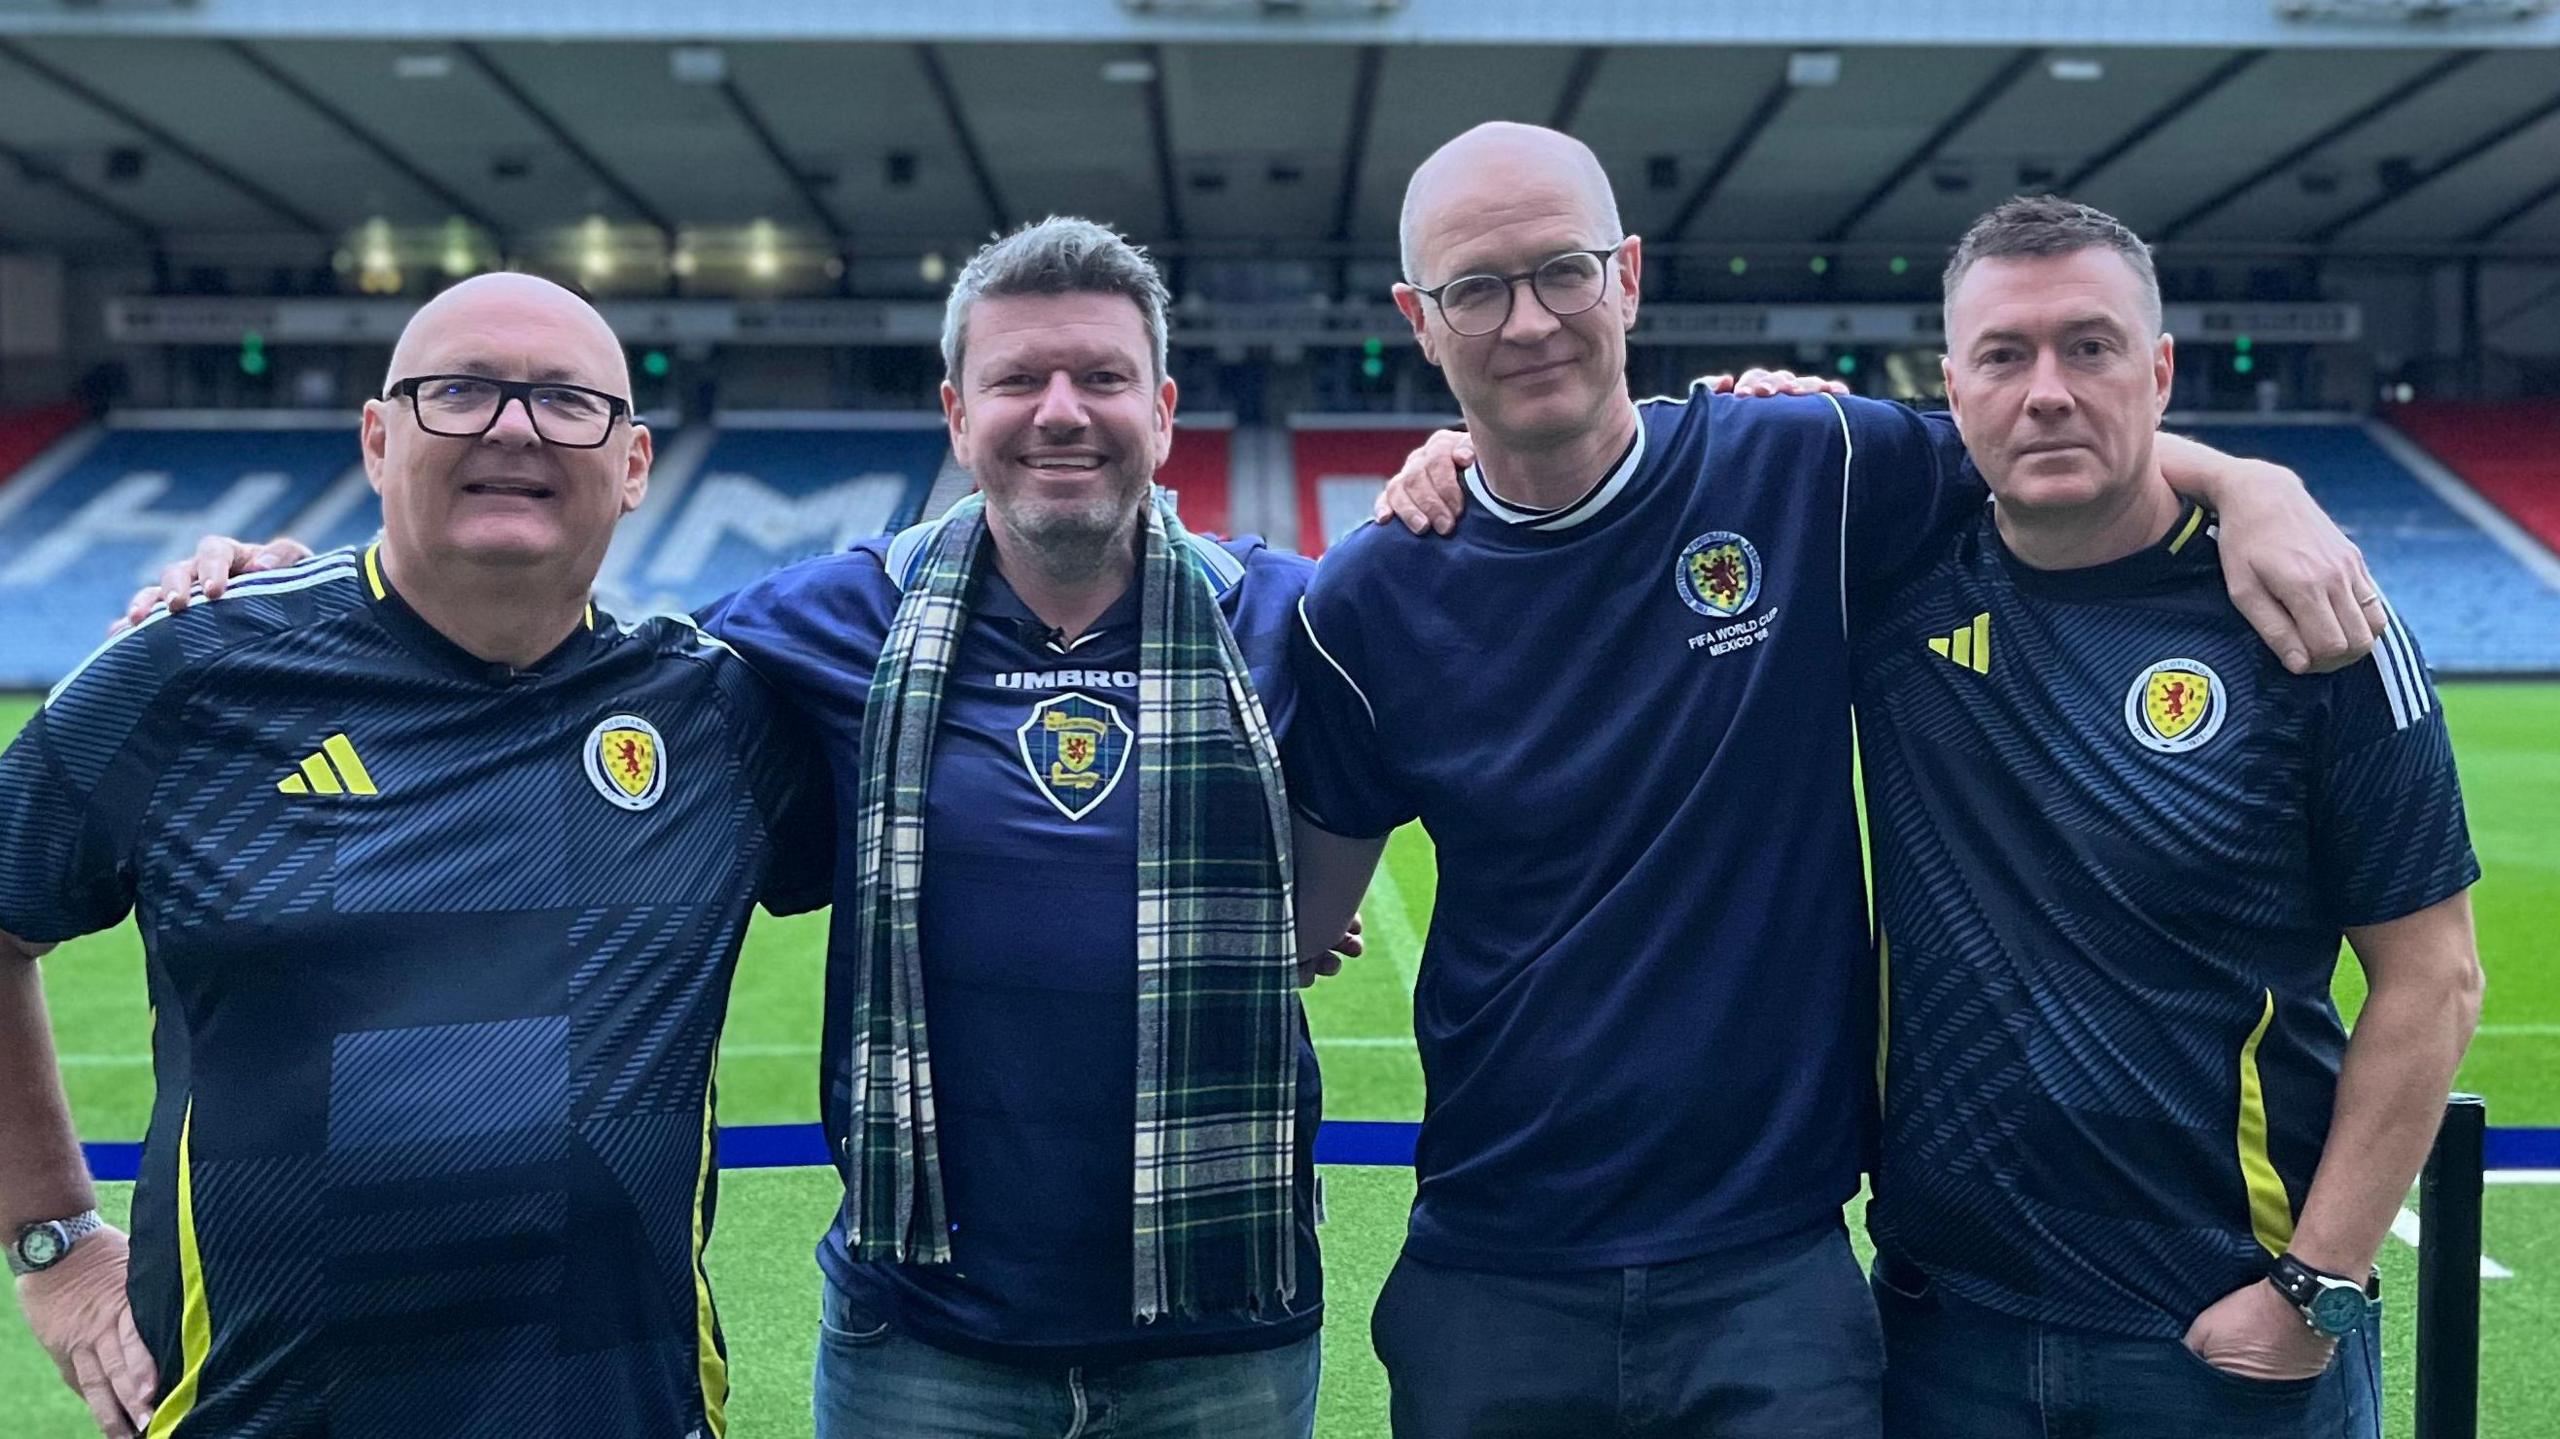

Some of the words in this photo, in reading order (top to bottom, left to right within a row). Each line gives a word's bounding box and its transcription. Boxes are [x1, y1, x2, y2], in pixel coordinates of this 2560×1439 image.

[1688, 632, 1715, 650] FIFA
[1716, 620, 1758, 640] WORLD
[1759, 607, 1778, 627] CUP
[1709, 635, 1753, 656] MEXICO
[995, 669, 1138, 689] UMBRO
